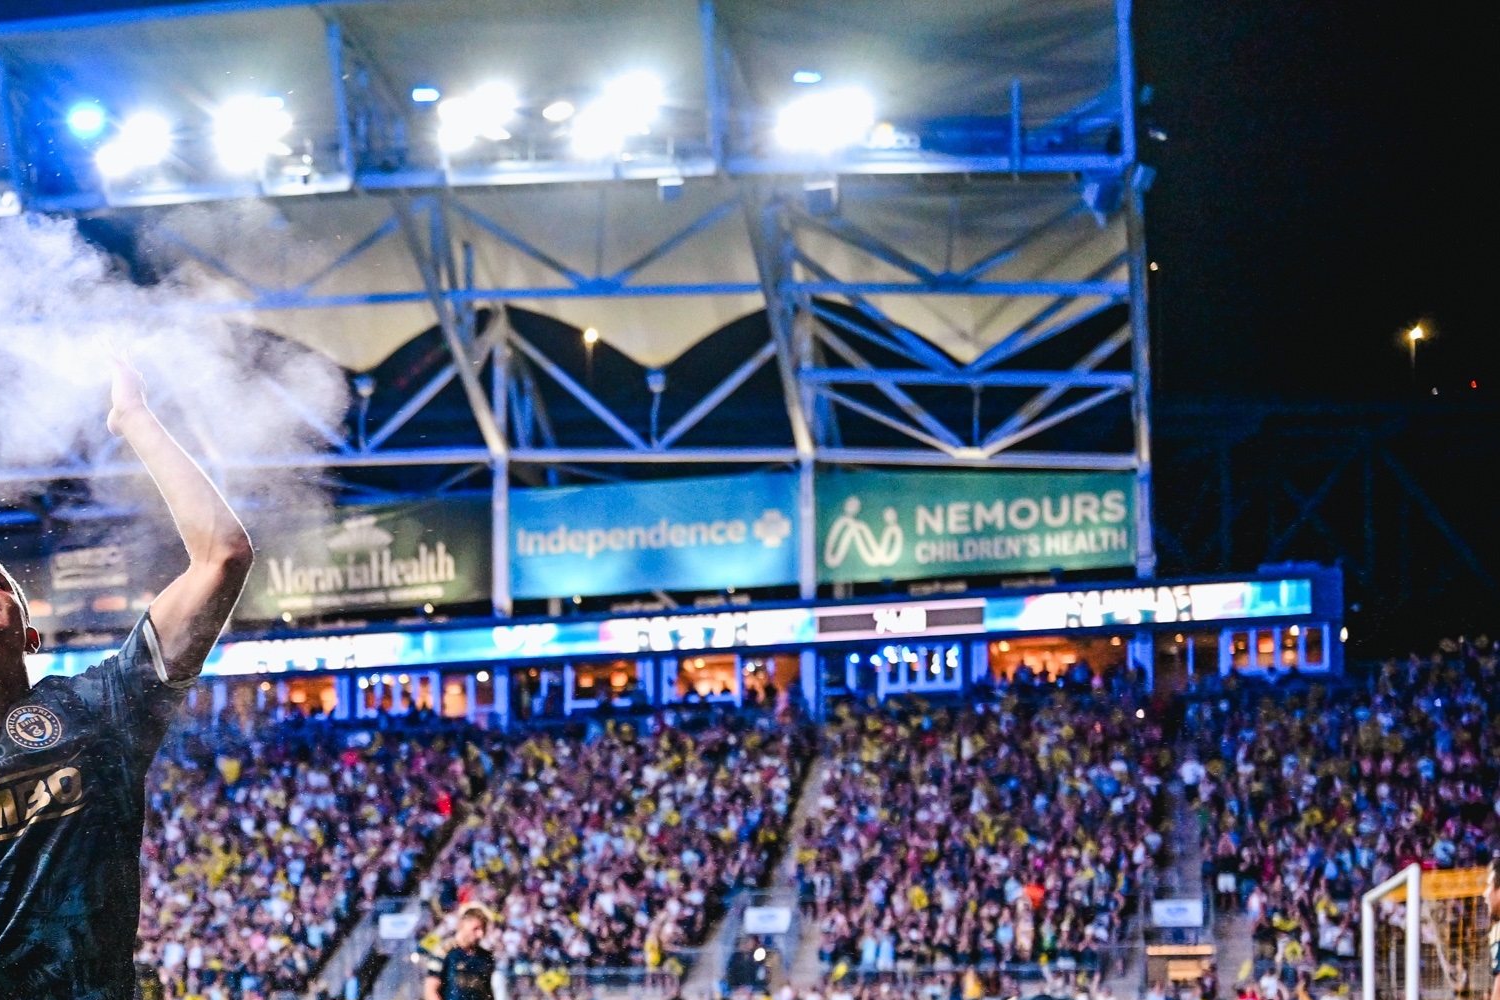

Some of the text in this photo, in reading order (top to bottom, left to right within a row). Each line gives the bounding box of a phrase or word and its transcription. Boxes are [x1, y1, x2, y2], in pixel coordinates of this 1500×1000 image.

[915, 490, 1127, 535] NEMOURS
[516, 518, 747, 558] Independence
[914, 527, 1127, 564] CHILDREN'S HEALTH
[8, 707, 52, 734] PHILADELPHIA
